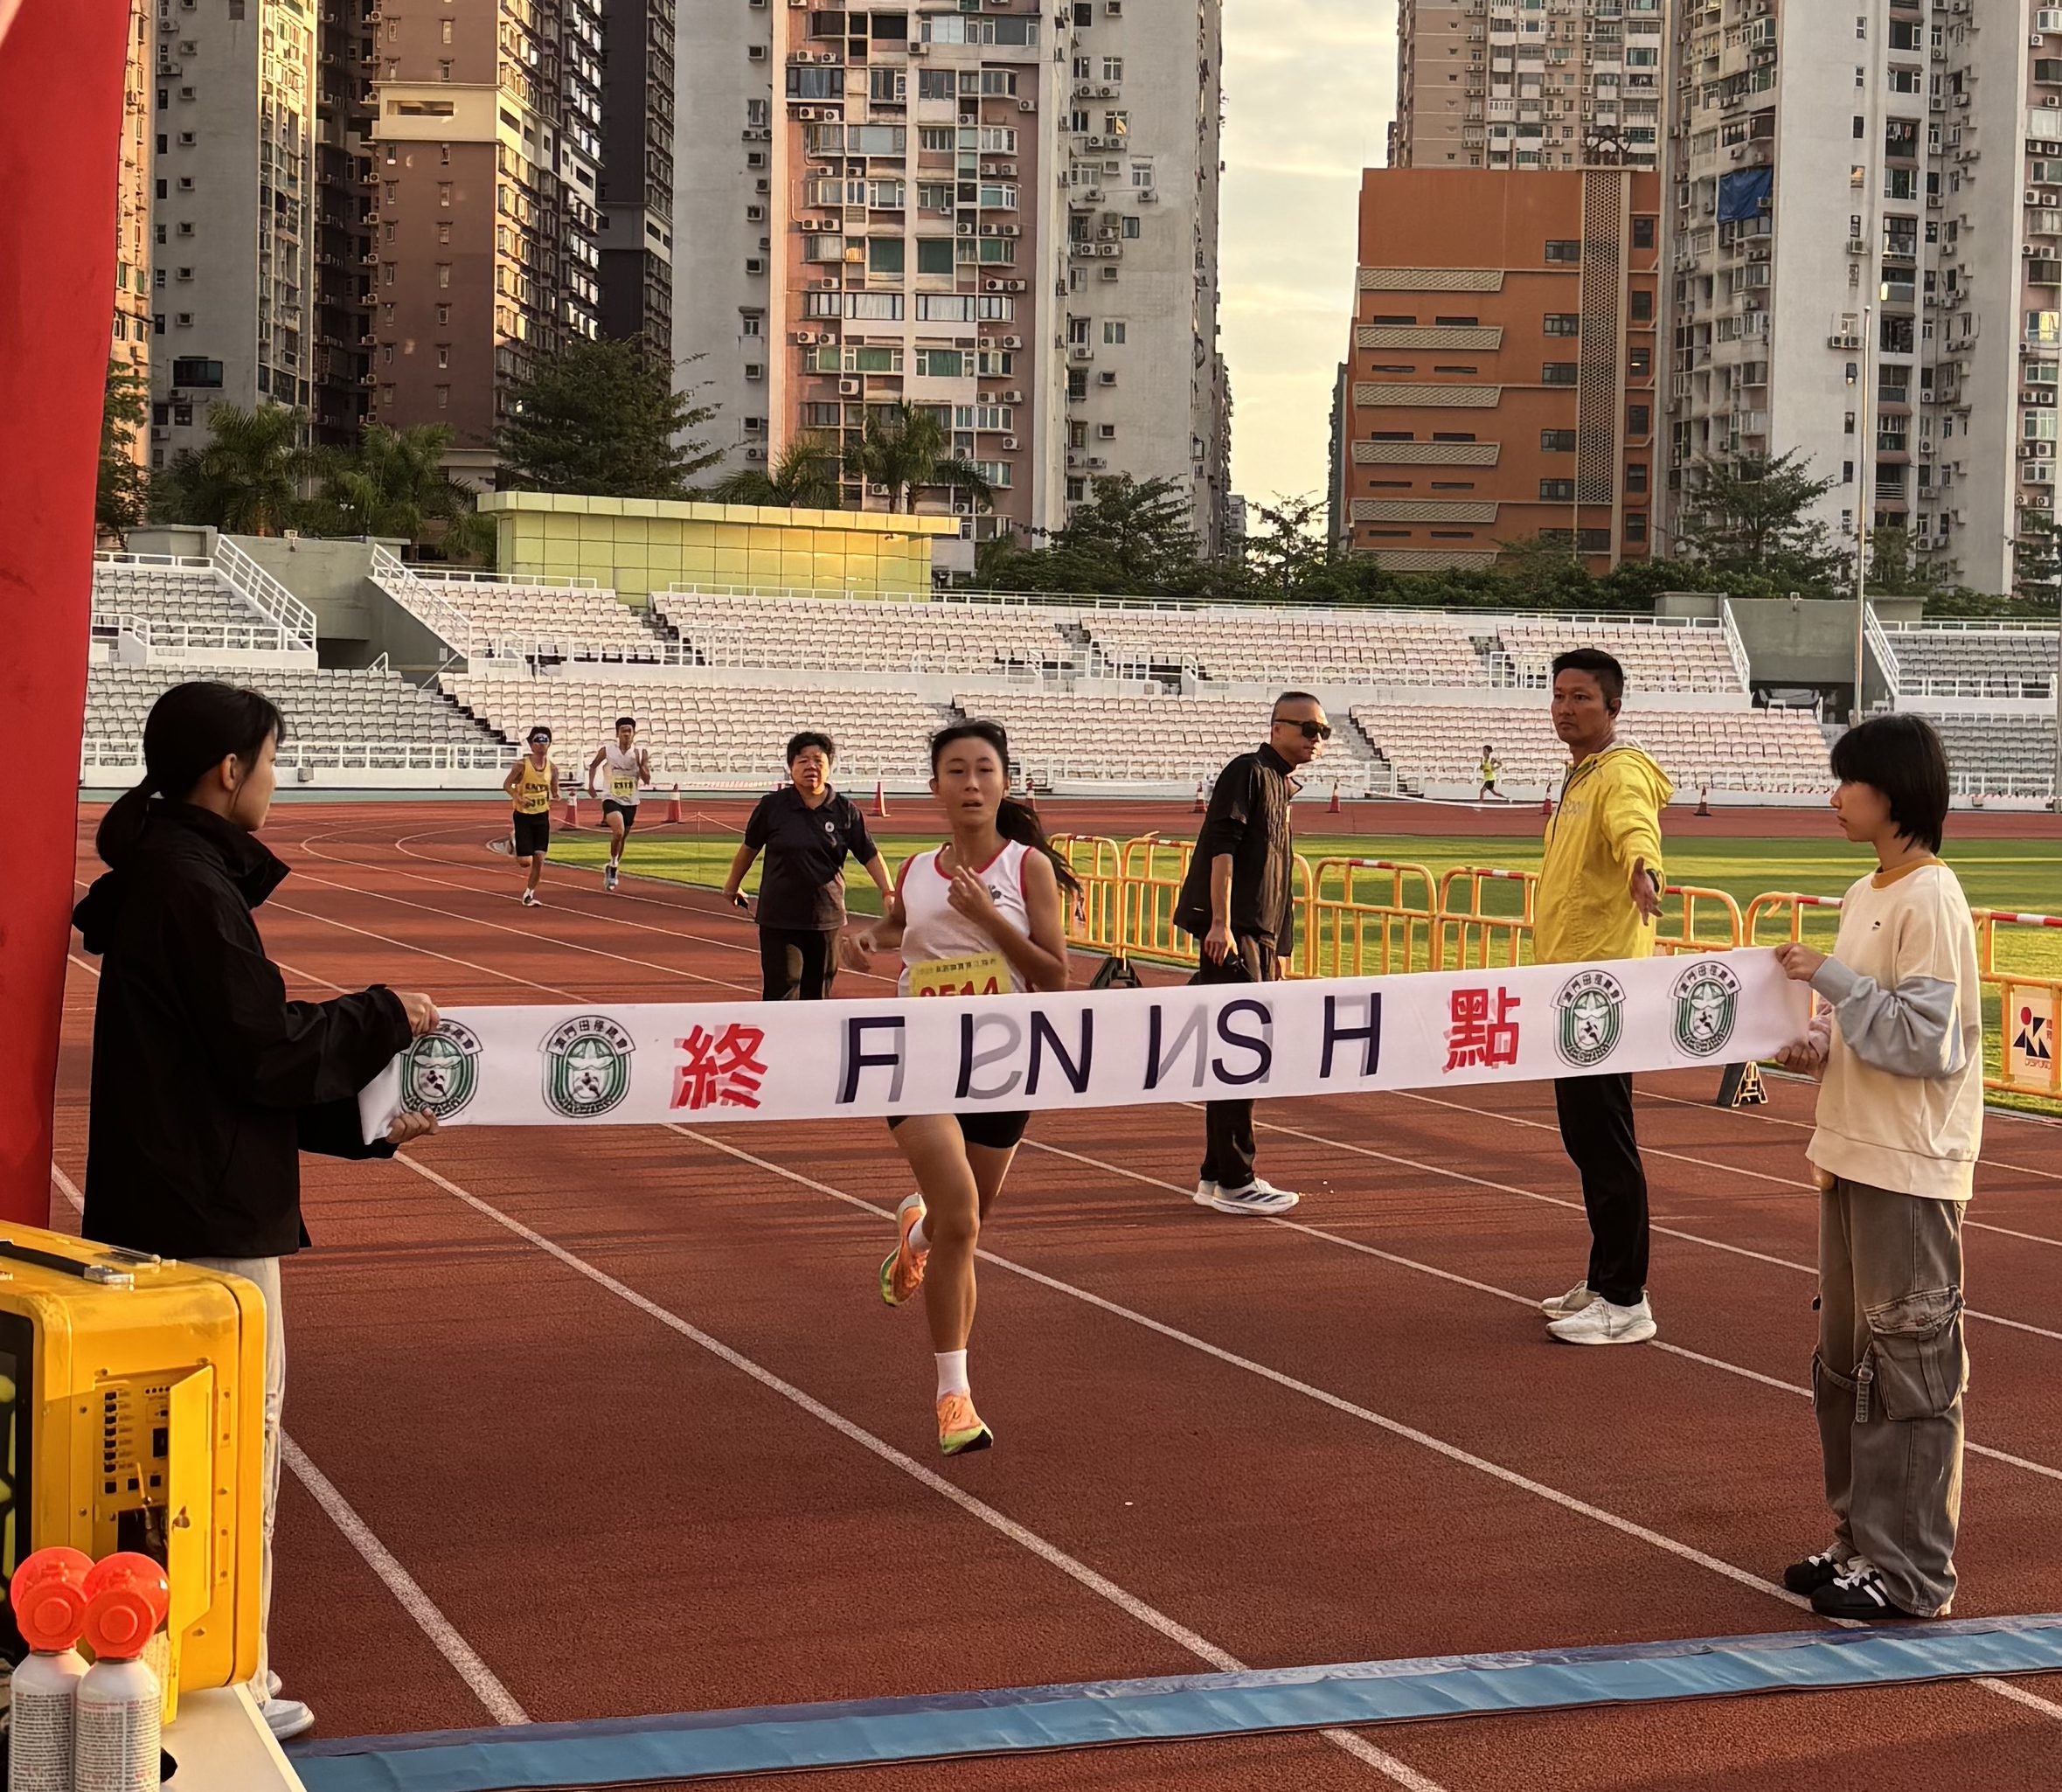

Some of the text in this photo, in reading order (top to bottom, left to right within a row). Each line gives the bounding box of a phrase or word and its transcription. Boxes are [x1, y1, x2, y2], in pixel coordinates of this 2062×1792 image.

[680, 987, 1520, 1108] 終 FINISH 點
